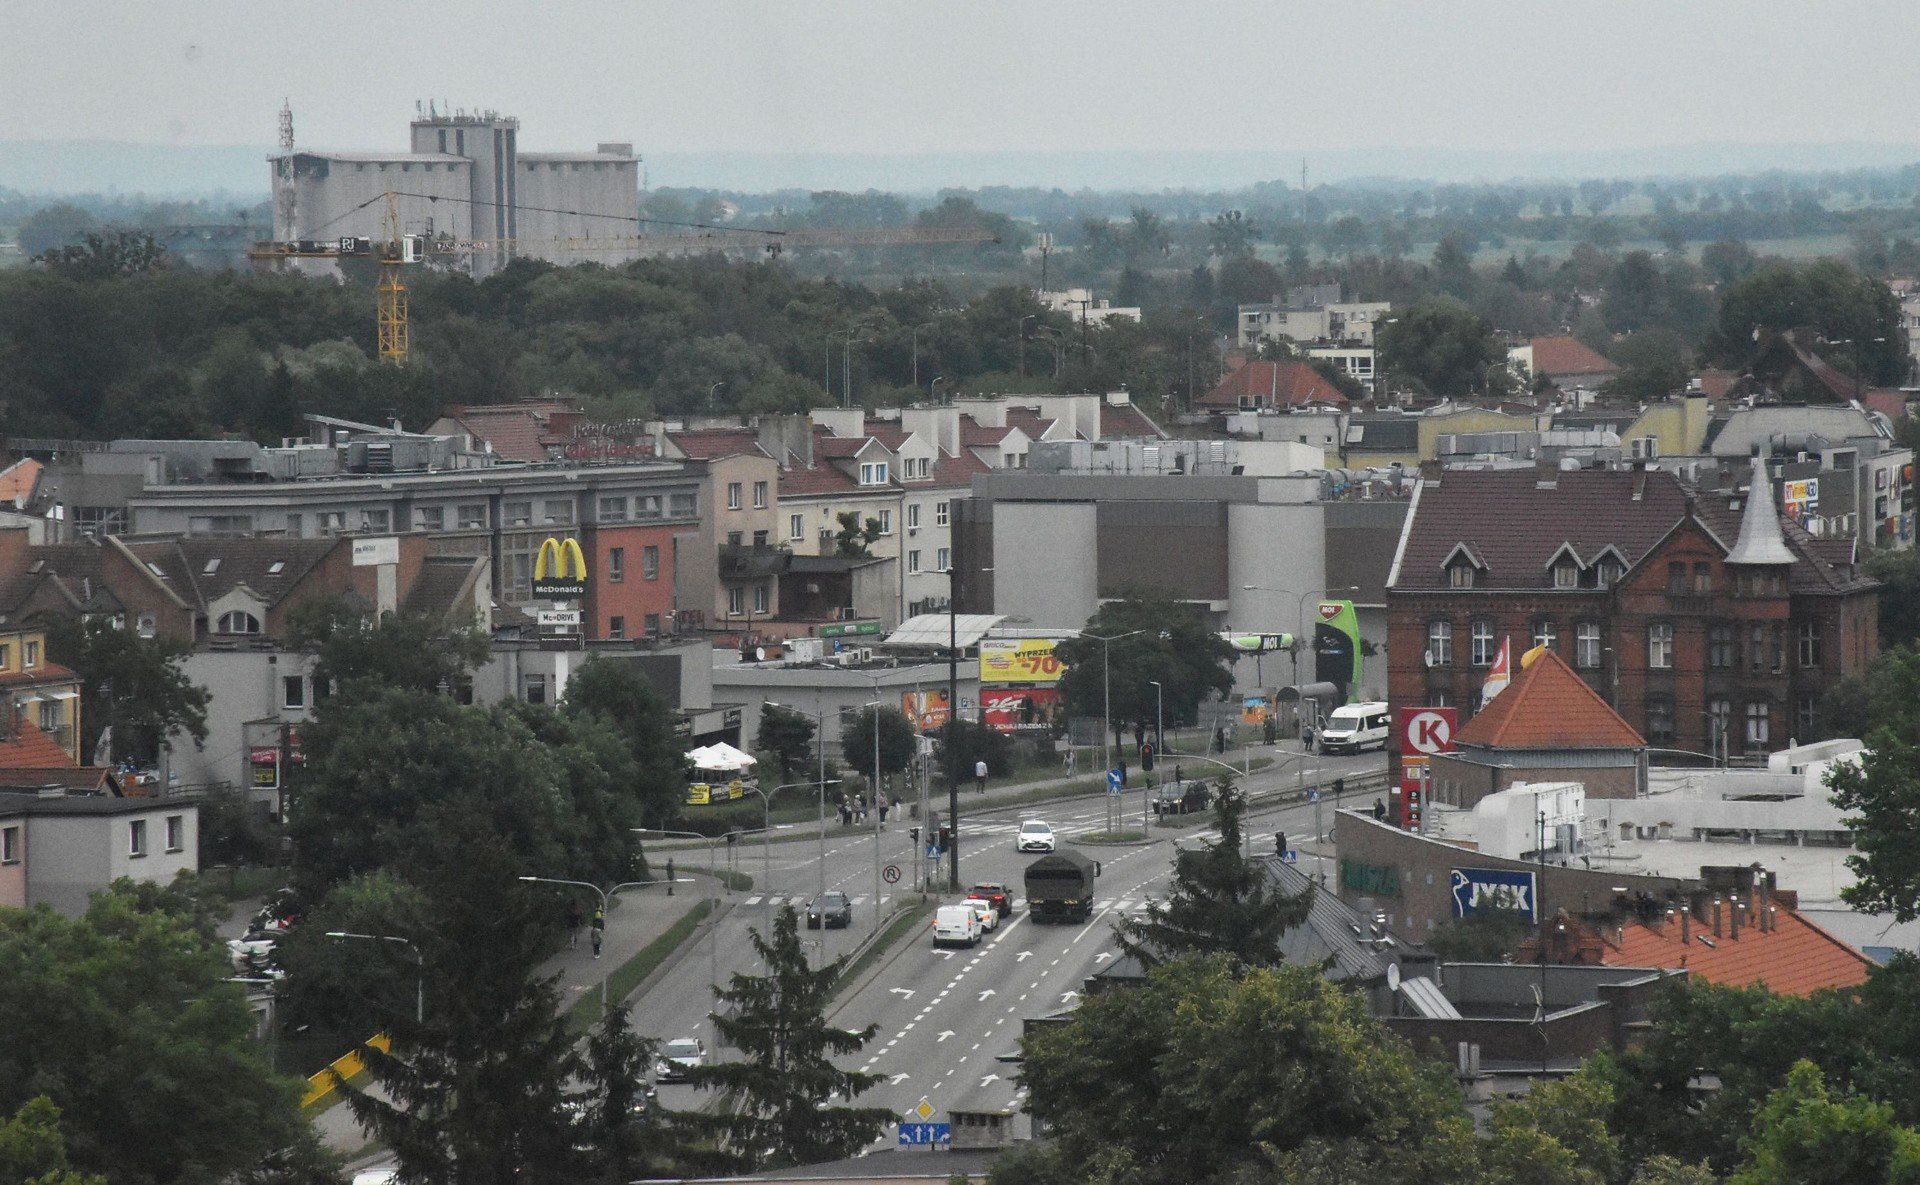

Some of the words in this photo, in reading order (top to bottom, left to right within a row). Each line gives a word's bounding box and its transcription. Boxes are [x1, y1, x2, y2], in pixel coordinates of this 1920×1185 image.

[1321, 606, 1335, 614] MOL
[1419, 720, 1449, 752] K
[1469, 882, 1530, 910] JYSK
